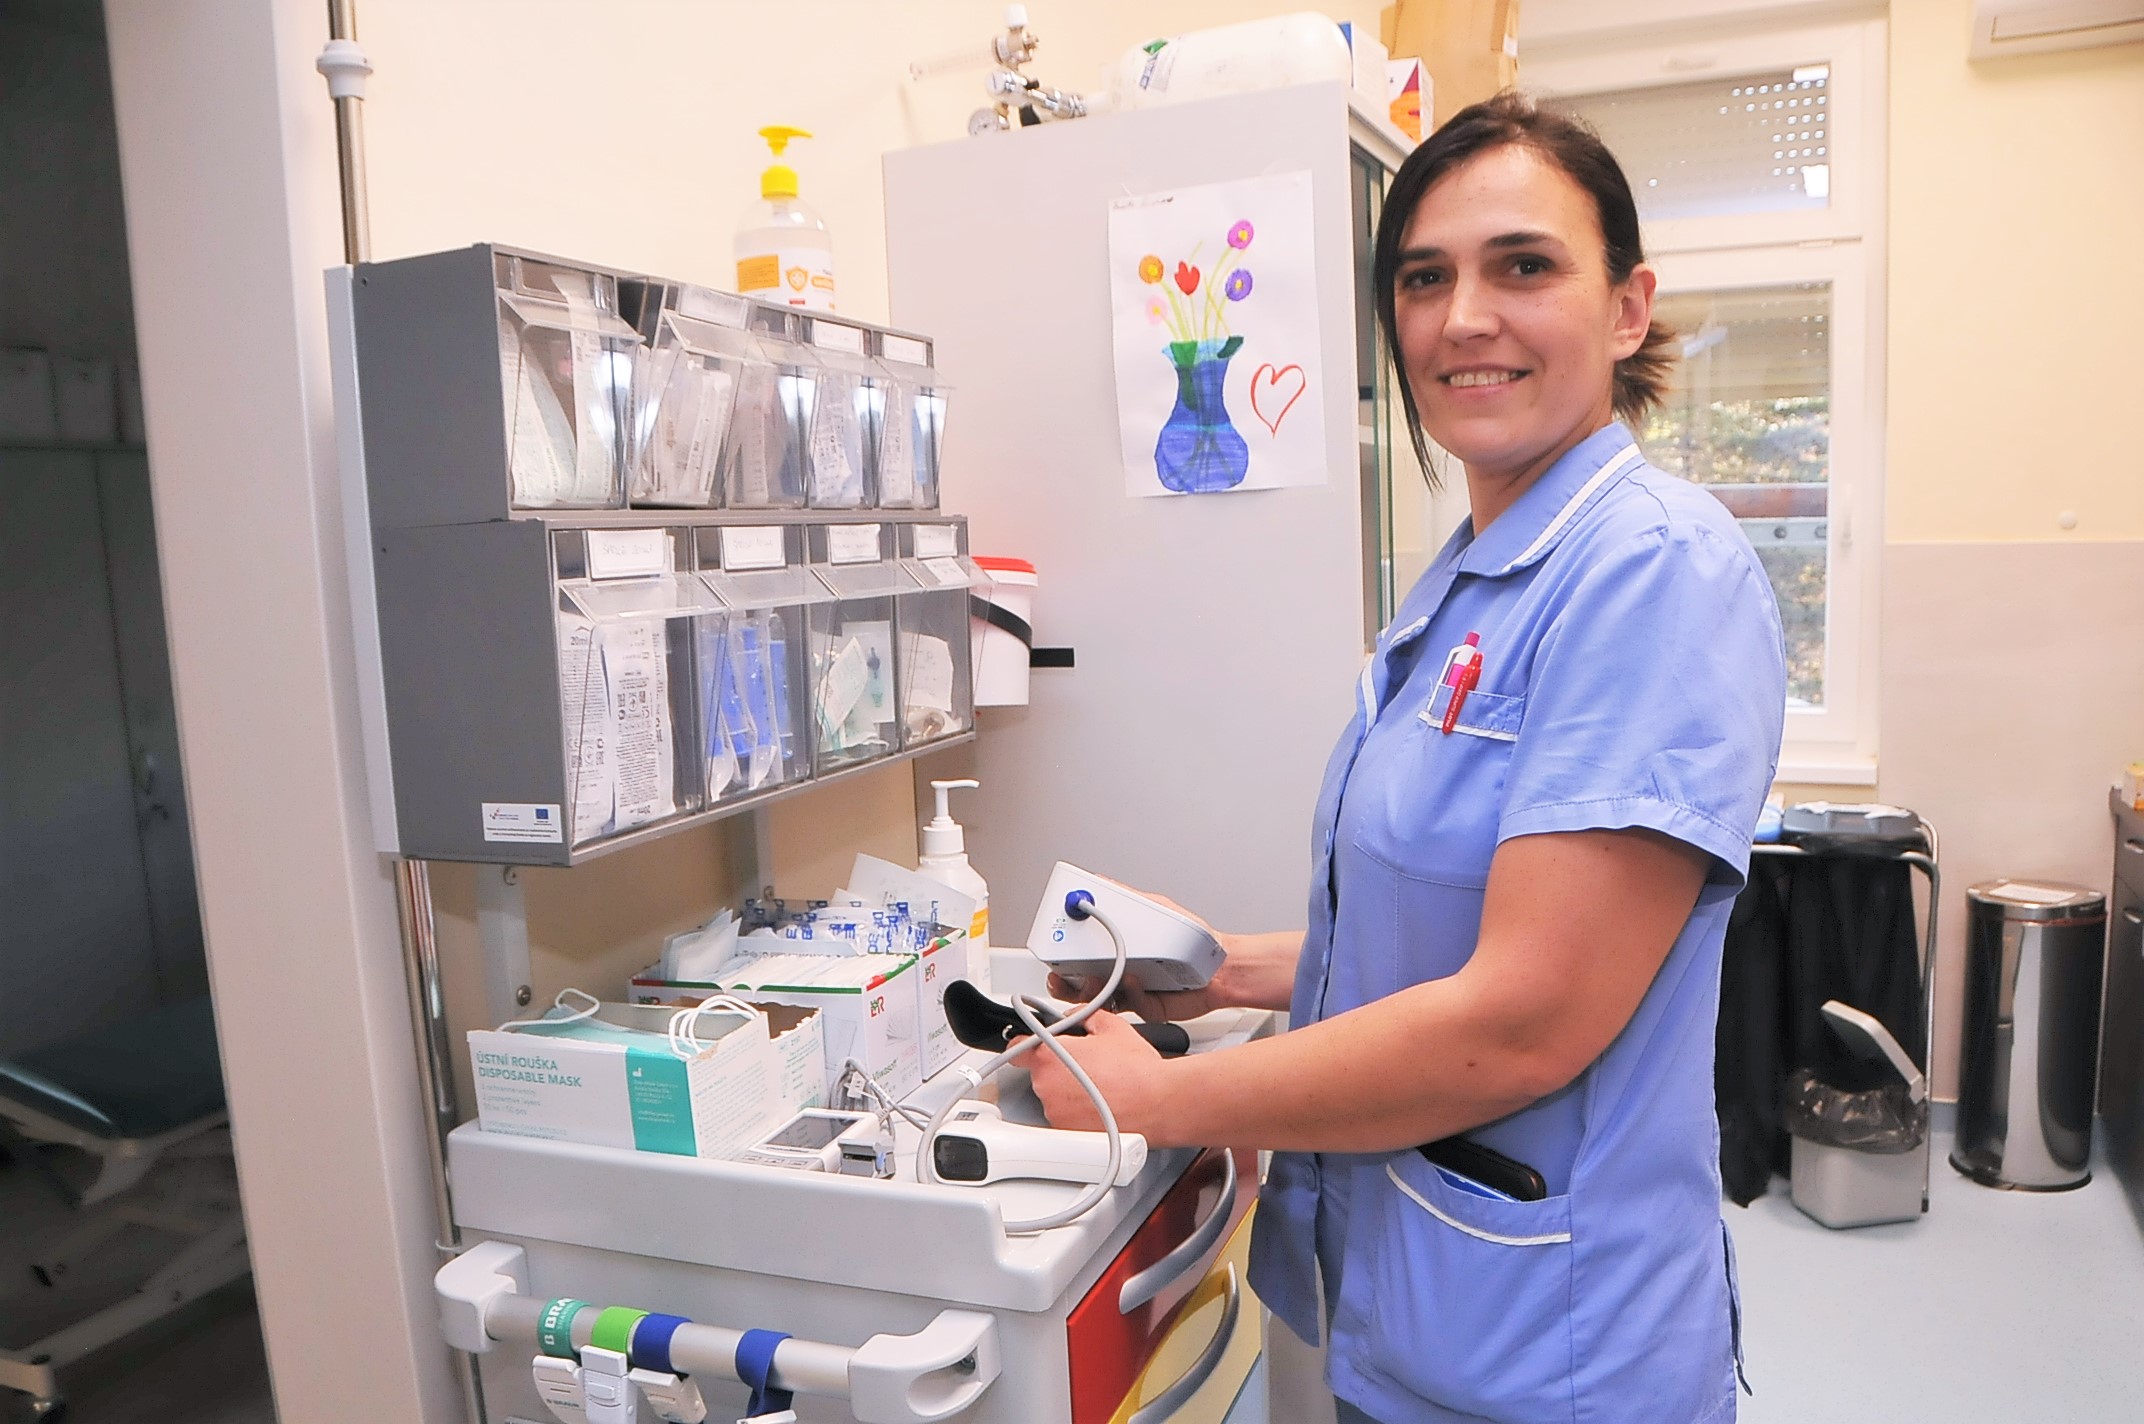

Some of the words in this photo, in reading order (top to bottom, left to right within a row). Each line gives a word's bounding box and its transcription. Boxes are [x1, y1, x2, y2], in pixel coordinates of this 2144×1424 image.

[476, 1051, 508, 1065] ÚSTNÍ
[511, 1056, 558, 1070] ROUŠKA
[478, 1067, 544, 1083] DISPOSABLE
[548, 1074, 582, 1087] MASK
